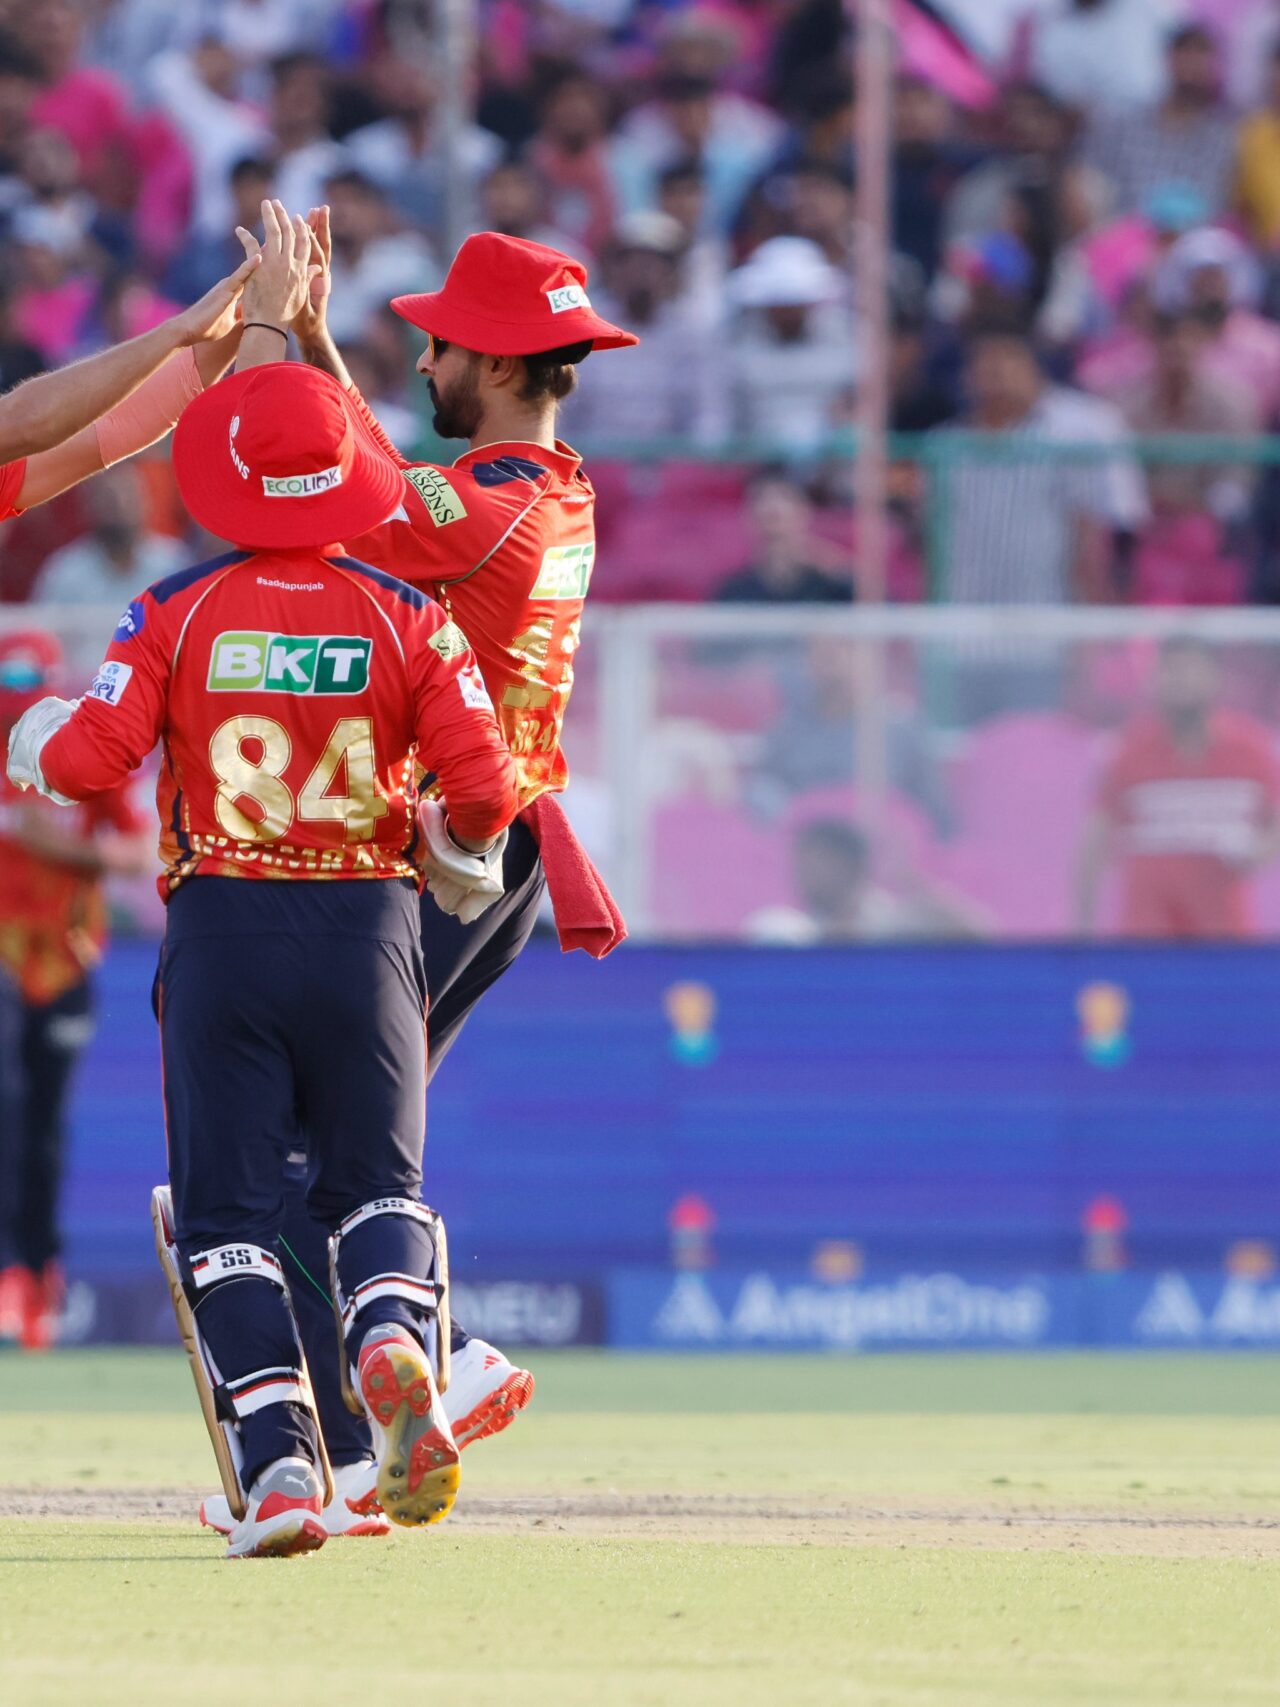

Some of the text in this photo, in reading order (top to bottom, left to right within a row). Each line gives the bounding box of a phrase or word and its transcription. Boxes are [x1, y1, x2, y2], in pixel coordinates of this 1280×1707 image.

[256, 576, 325, 592] #saddapunjab
[215, 643, 366, 683] BKT
[209, 714, 389, 843] 84
[221, 1249, 253, 1269] SS
